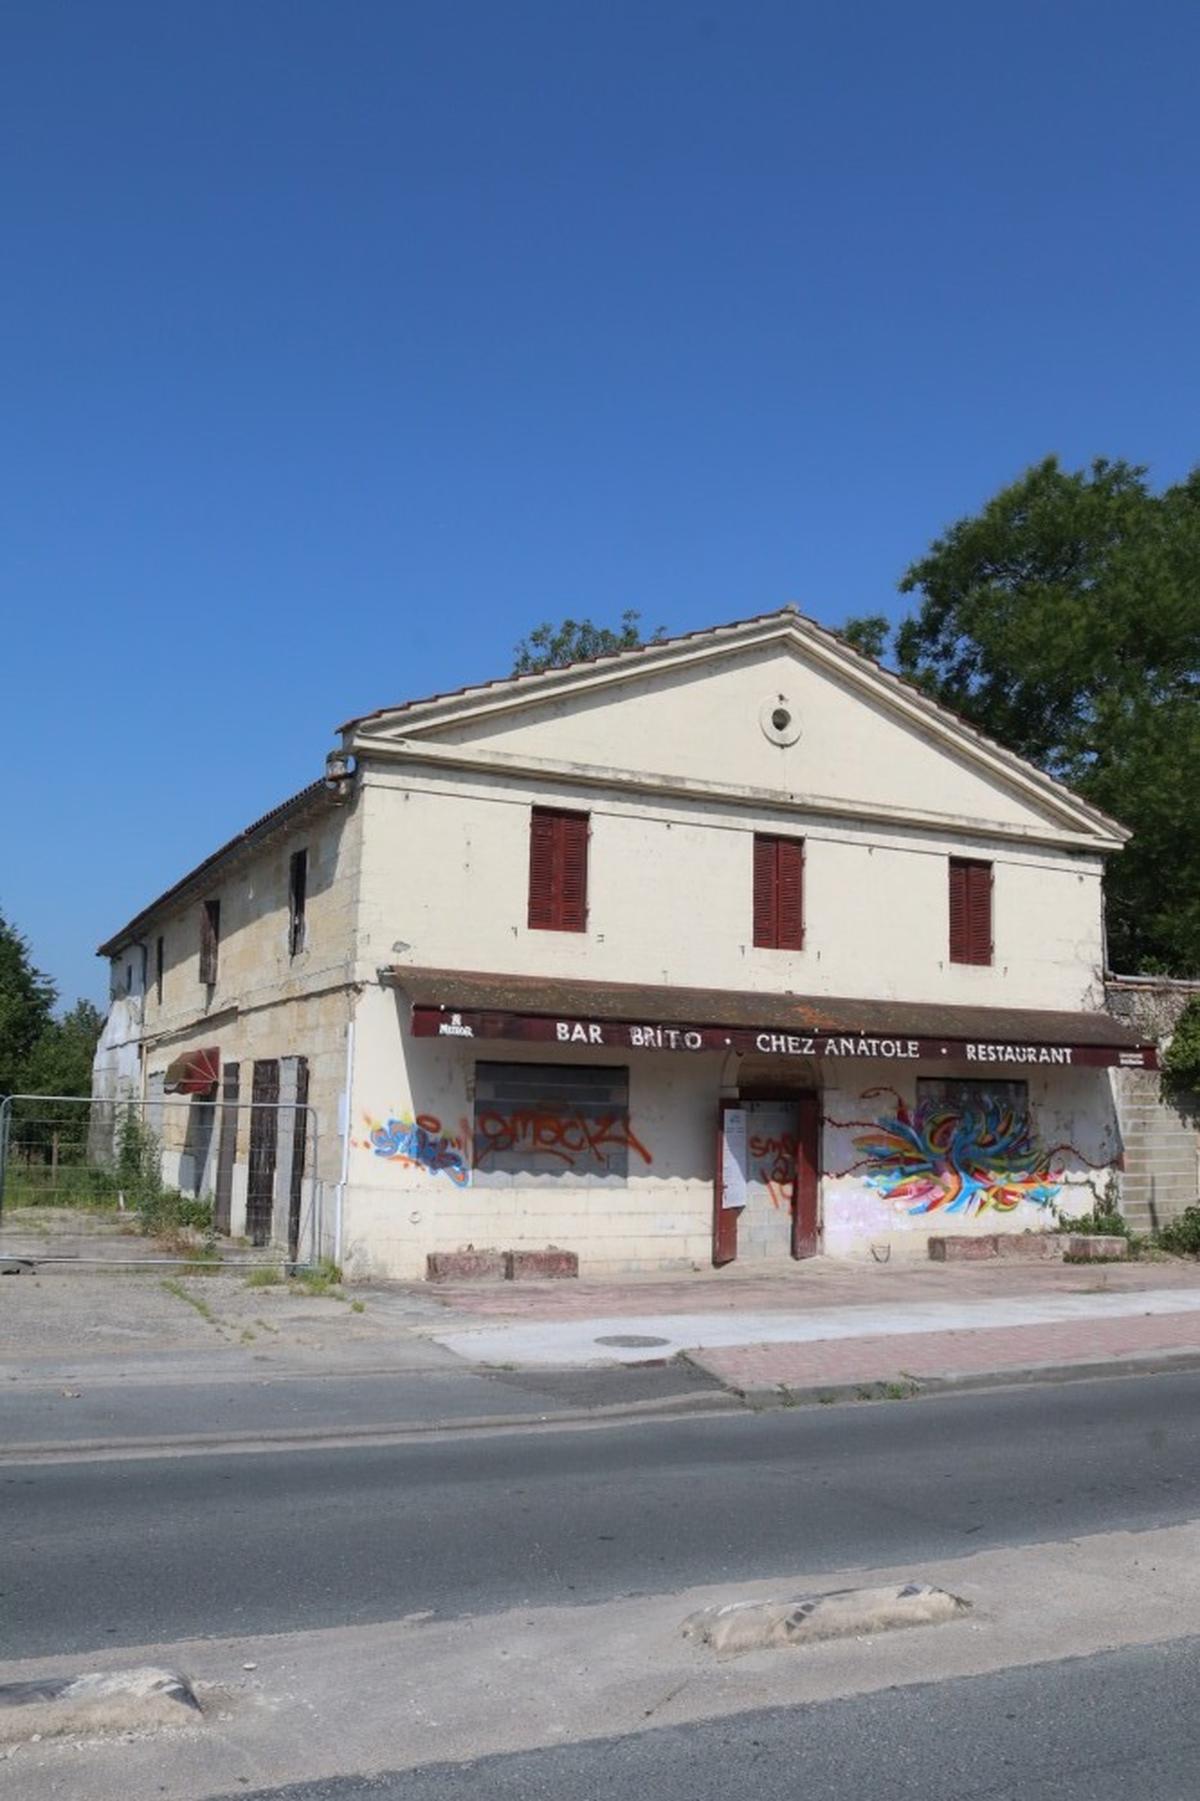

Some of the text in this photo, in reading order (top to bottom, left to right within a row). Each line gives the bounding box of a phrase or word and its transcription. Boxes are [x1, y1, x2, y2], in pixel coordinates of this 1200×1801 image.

[556, 1022, 603, 1044] BAR
[756, 1034, 816, 1054] CHEZ
[824, 1038, 920, 1058] ANATOLE
[966, 1044, 1073, 1064] RESTAURANT
